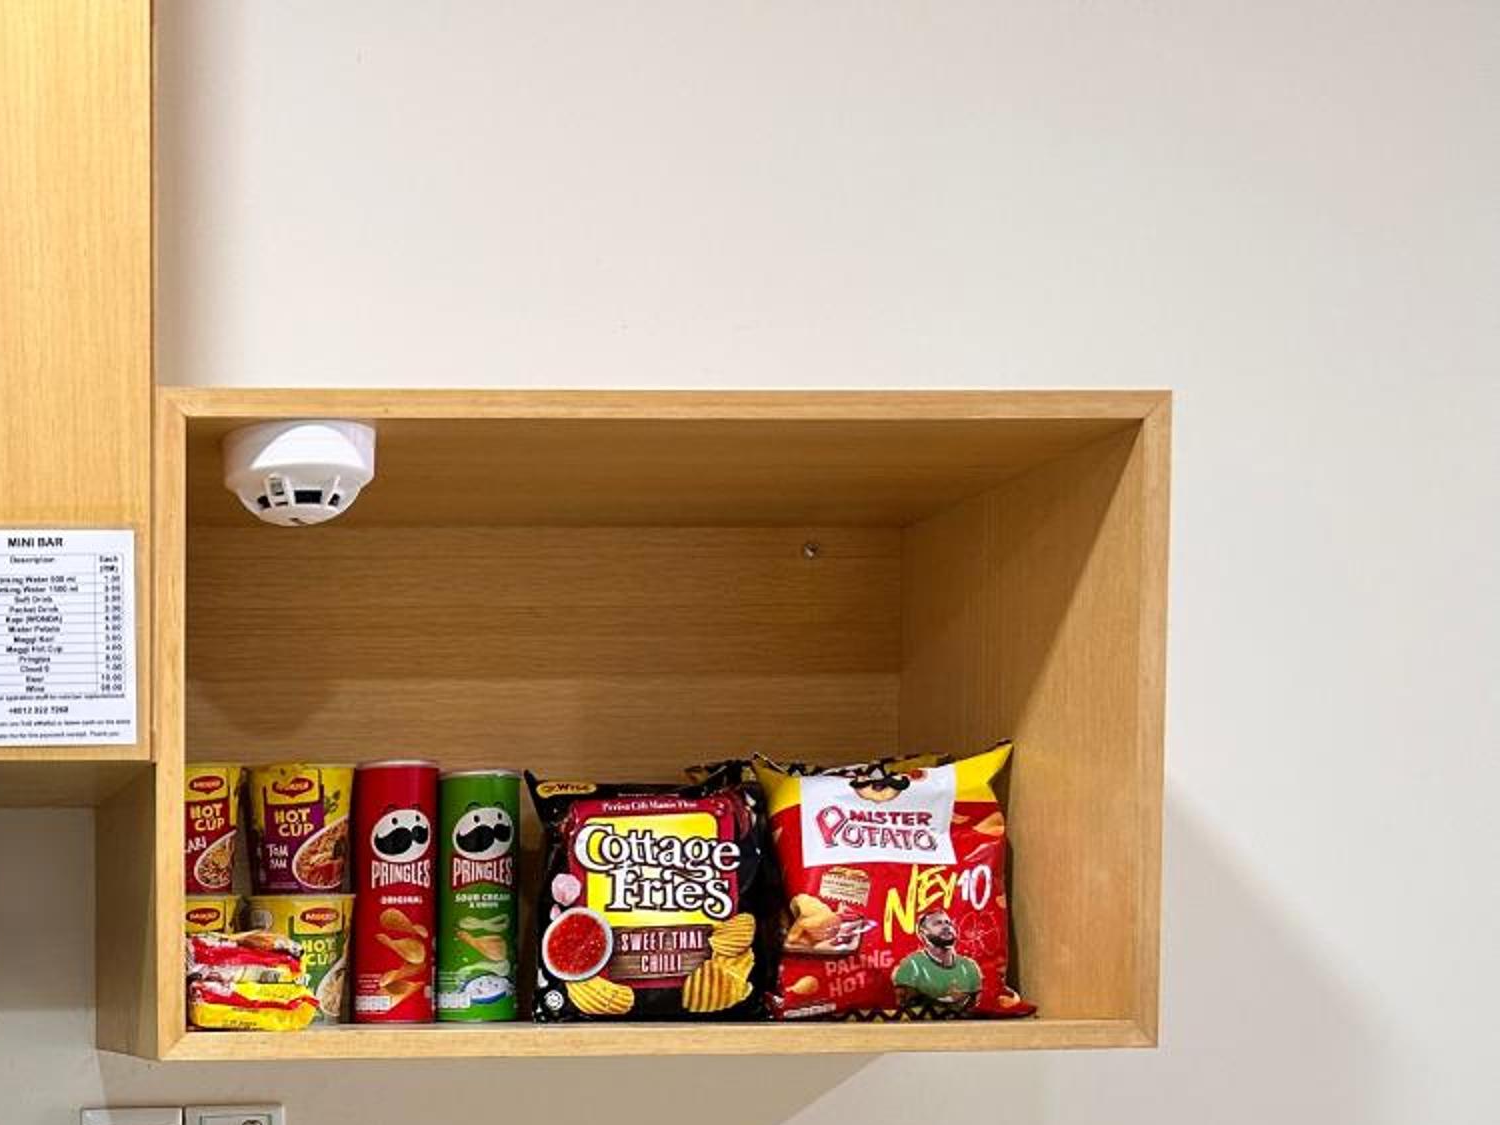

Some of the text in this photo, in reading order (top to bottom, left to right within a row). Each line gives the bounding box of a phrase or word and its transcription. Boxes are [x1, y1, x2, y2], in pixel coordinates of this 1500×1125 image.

[7, 537, 64, 548] MINI BAR
[18, 655, 51, 664] Pringles
[189, 803, 223, 820] HOT
[273, 808, 311, 824] HOT
[849, 809, 933, 827] MISTER
[194, 818, 226, 832] CUP
[278, 823, 315, 837] CUP
[815, 805, 939, 851] POTATO
[574, 822, 742, 883] Cottage
[370, 858, 432, 890] PRINGLES
[452, 856, 514, 888] PRINGLES
[379, 895, 424, 905] ORIGINAL
[454, 892, 480, 903] SOUR
[605, 861, 734, 922] Fries
[301, 938, 337, 952] HOT
[621, 930, 704, 952] SWEET THAI
[305, 953, 338, 966] CUP
[640, 954, 683, 974] CHILLI
[824, 948, 895, 977] PALING
[828, 970, 867, 998] HOT
